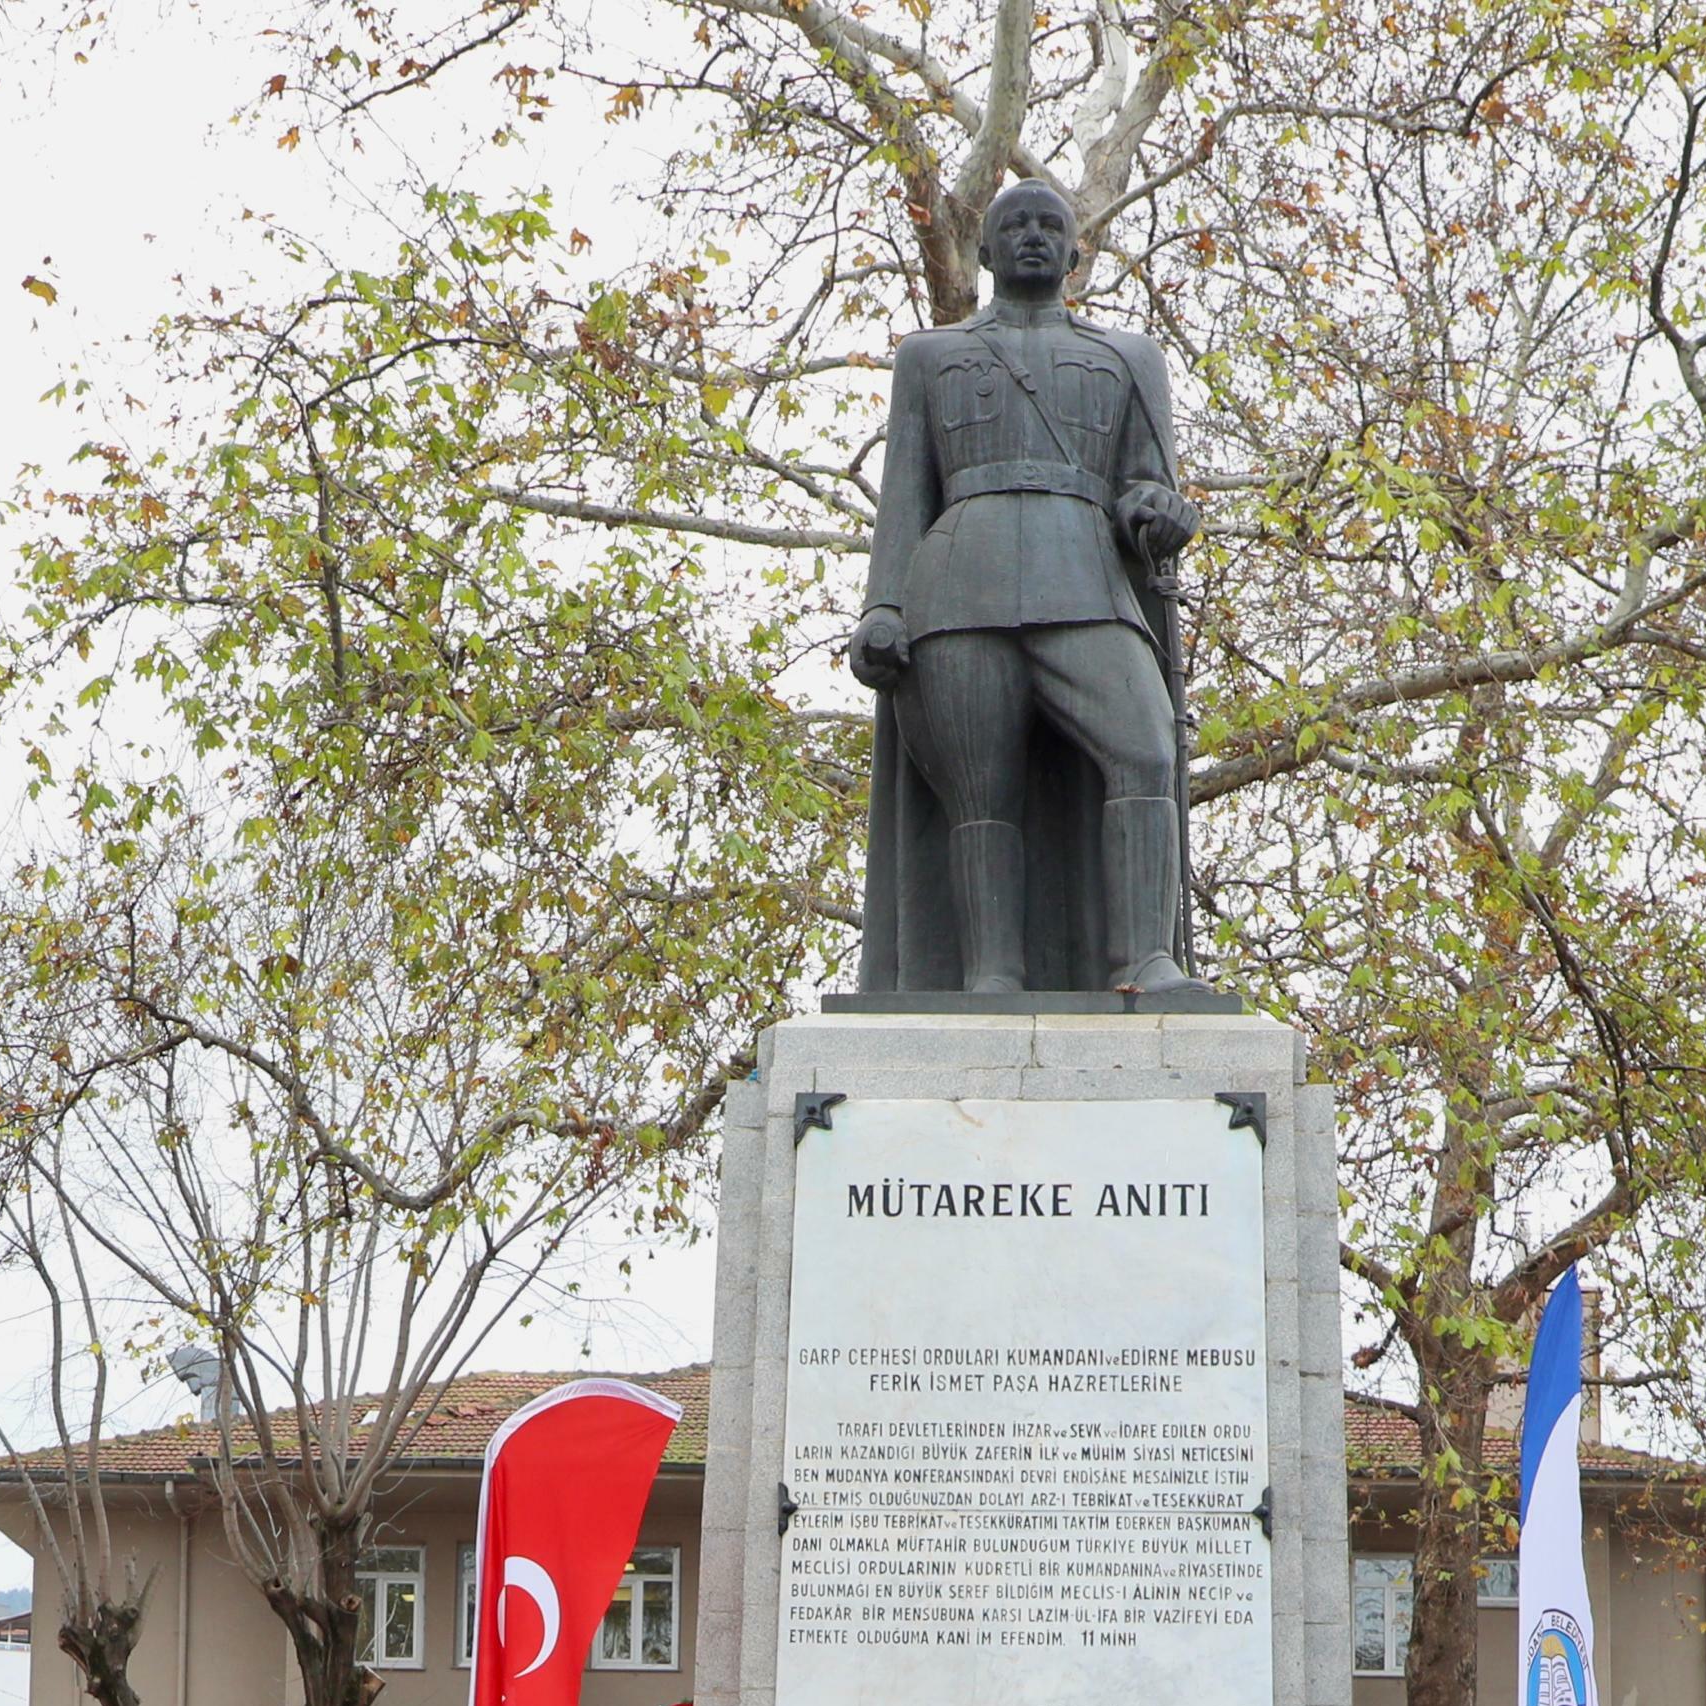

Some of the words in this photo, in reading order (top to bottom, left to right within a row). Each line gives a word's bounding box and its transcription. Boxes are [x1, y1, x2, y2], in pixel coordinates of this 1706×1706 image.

[847, 1178, 1073, 1217] MÜTAREKE
[1095, 1183, 1209, 1217] ANITI
[800, 1348, 840, 1365] GARP
[849, 1346, 916, 1365] CEPHESİ
[923, 1348, 998, 1365] ORDULARI
[1187, 1349, 1255, 1366] MEBUSU
[870, 1372, 921, 1392] FERİK
[930, 1371, 984, 1392] İSMET
[994, 1374, 1038, 1393] PAŞA
[1049, 1373, 1182, 1392] HAZRETLERİNE
[837, 1423, 882, 1437] TARAFI
[889, 1421, 1005, 1437] DEVLETLERİNDEN
[796, 1446, 832, 1459] LARIN
[922, 1443, 967, 1460] BÜYÜK
[975, 1444, 1032, 1460] ZAFERİN
[1040, 1443, 1059, 1460] İLK
[1063, 1449, 1077, 1460] ve
[1081, 1444, 1125, 1461] MÜHİM
[1182, 1445, 1253, 1462] NETİCESİNİ
[795, 1468, 819, 1482] BEN
[826, 1468, 888, 1483] MUDANYA
[894, 1467, 1013, 1483] KONFERANSINDAKİ
[824, 1492, 862, 1506] ETMİŞ
[869, 1490, 972, 1506] OLDUĞUNUZDAN
[980, 1493, 1023, 1506] DOLAYI
[793, 1513, 843, 1528] EYLERİM
[1062, 1514, 1109, 1529] TAKTİM
[1116, 1516, 1171, 1530] EDERKEN
[793, 1538, 821, 1552] DANI
[830, 1538, 889, 1552] OLMAKLA
[897, 1536, 966, 1552] MÜFTAHİR
[1076, 1538, 1134, 1553] TÜRKİYE
[1142, 1538, 1188, 1553] BÜYÜK
[1197, 1537, 1252, 1554] MİLLET
[858, 1561, 956, 1575] ORDULARININ
[965, 1559, 1032, 1576] KUDRETLİ
[1039, 1560, 1060, 1576] BİR
[876, 1584, 892, 1597] EN
[899, 1583, 942, 1598] BÜYÜK
[863, 1604, 885, 1621] BİR
[893, 1607, 974, 1621] MENSUBUNA
[1124, 1607, 1145, 1623] BİR
[1225, 1610, 1253, 1624] EDA
[790, 1629, 847, 1644] ETMEKTE
[857, 1628, 929, 1644] OLDUĞUMA
[1081, 1630, 1094, 1646] 11
